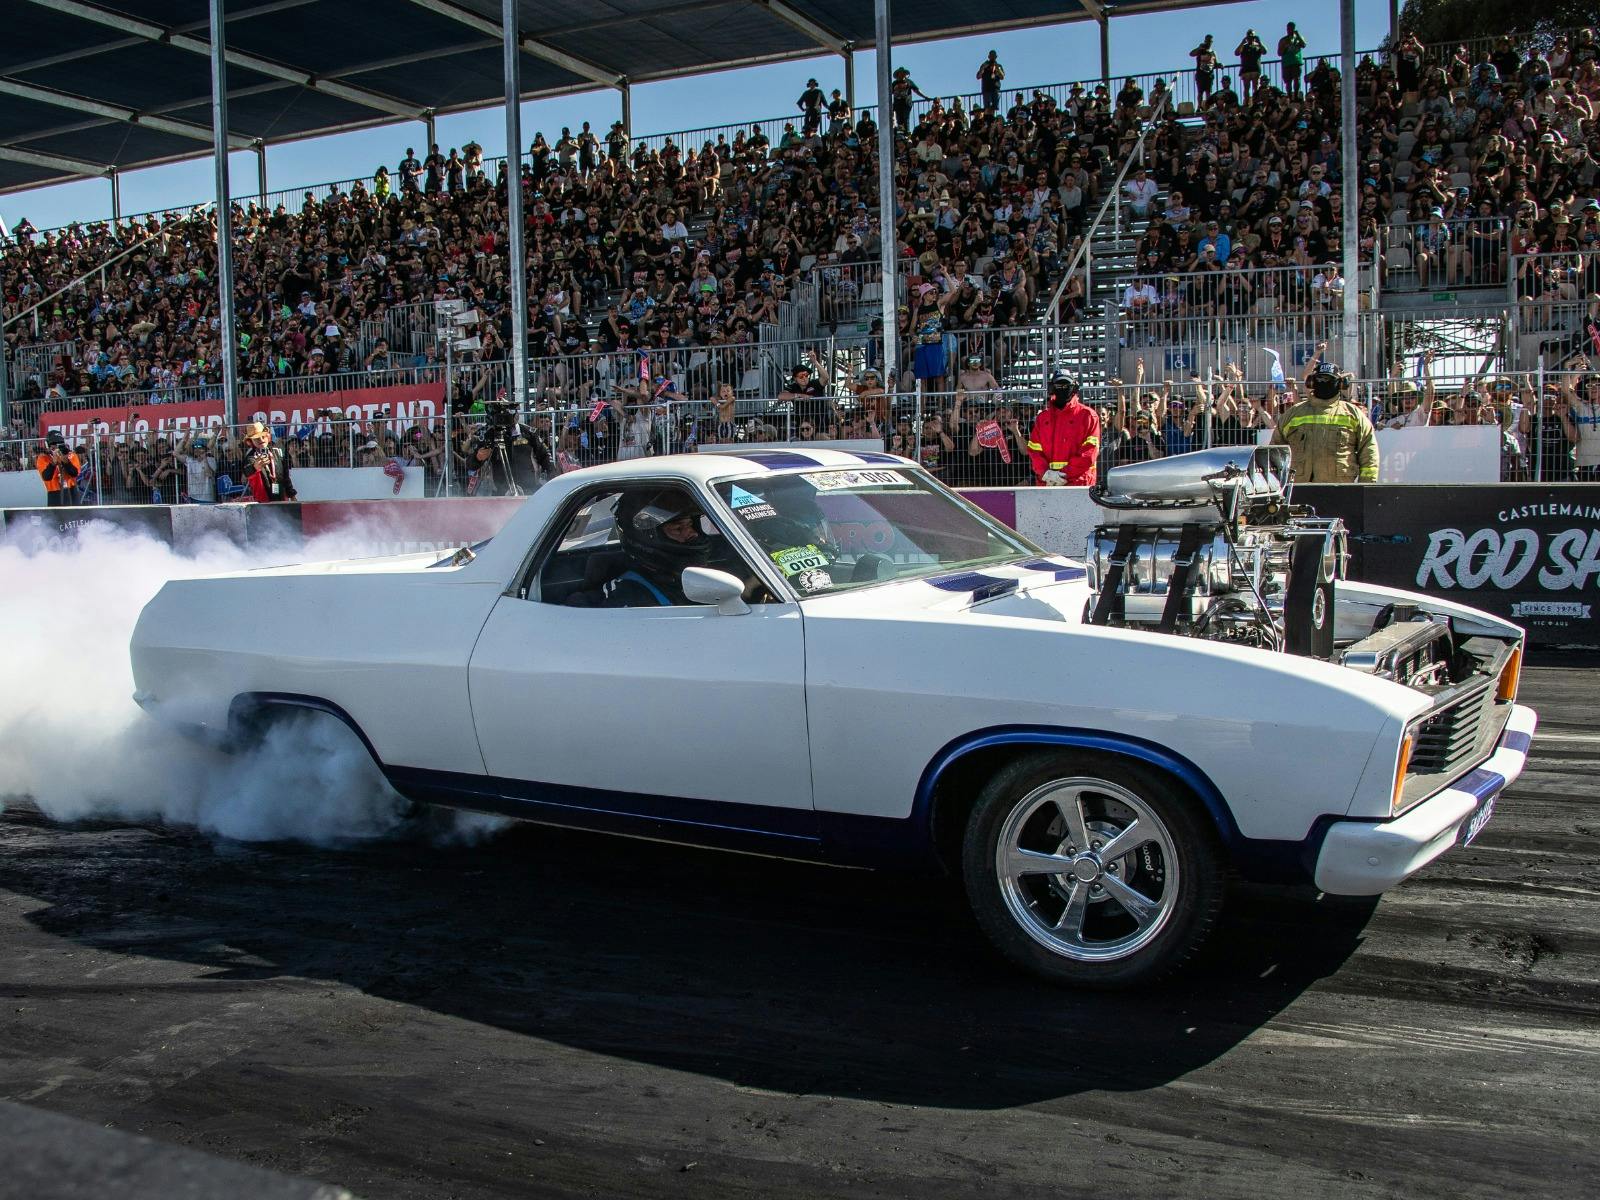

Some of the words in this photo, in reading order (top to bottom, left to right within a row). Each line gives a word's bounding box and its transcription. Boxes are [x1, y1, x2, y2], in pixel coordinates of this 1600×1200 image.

[158, 414, 227, 441] HENR
[860, 472, 898, 483] 0107
[790, 557, 821, 571] 0107
[1416, 528, 1540, 590] ROD
